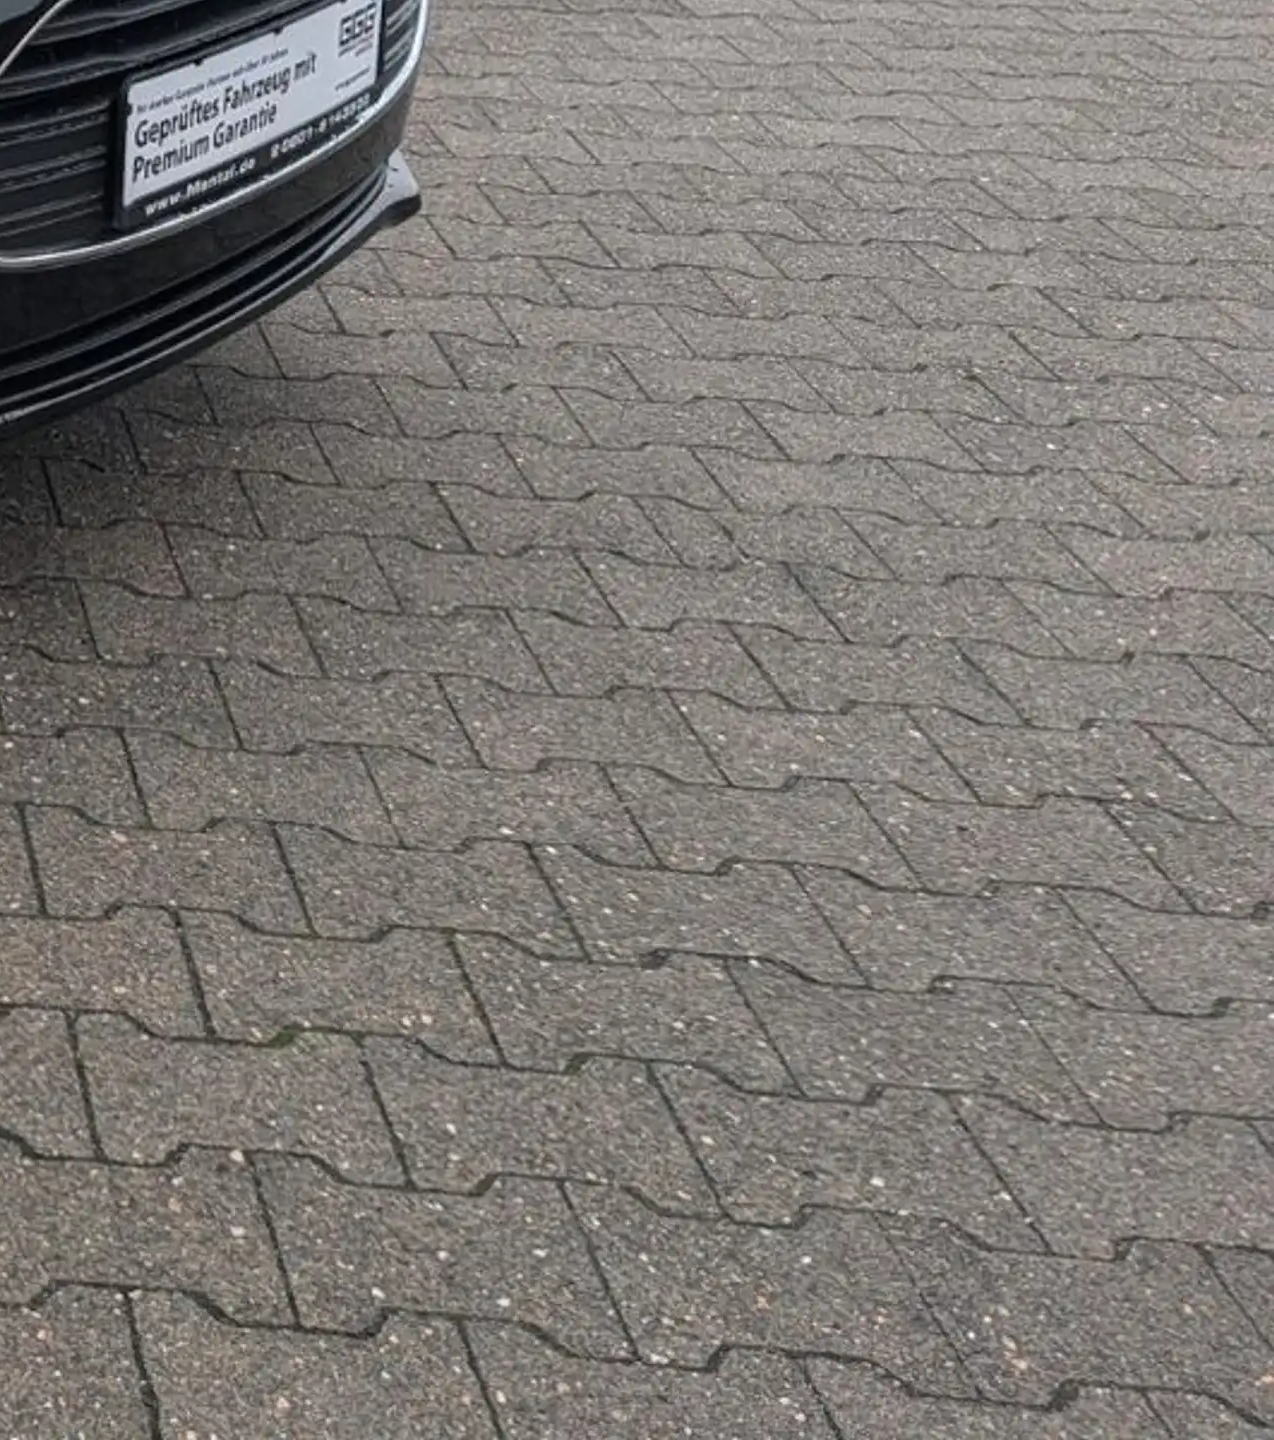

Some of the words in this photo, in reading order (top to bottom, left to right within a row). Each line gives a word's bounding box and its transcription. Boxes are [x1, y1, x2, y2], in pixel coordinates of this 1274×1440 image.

[132, 135, 210, 183] Premium
[212, 100, 278, 149] Garantie
[134, 97, 220, 148] Geprüftes
[222, 62, 291, 114] Fahrzeug
[293, 51, 318, 82] mit
